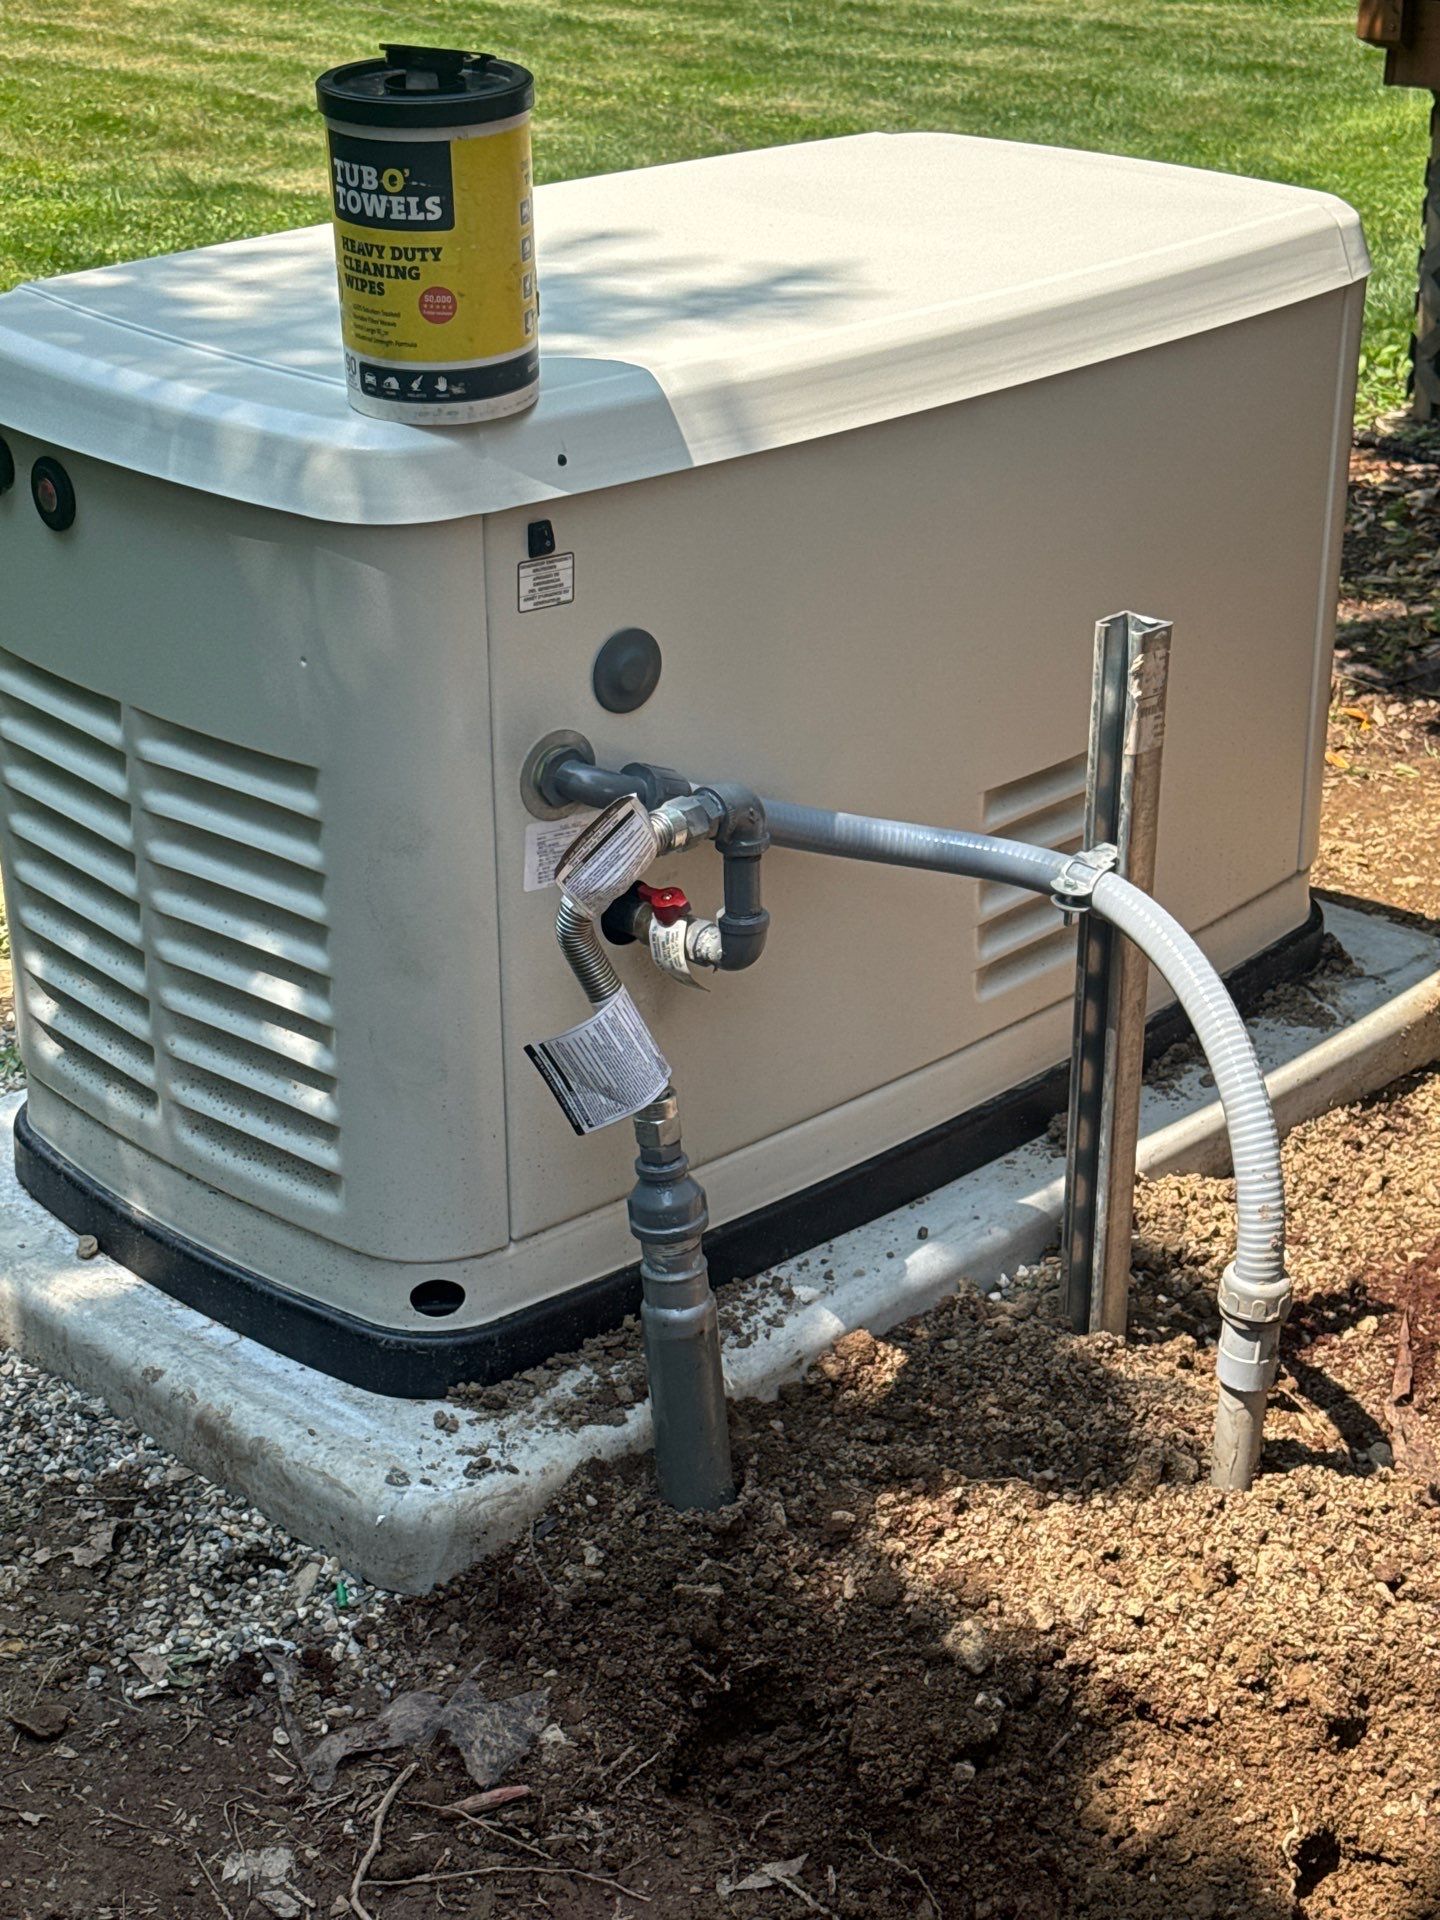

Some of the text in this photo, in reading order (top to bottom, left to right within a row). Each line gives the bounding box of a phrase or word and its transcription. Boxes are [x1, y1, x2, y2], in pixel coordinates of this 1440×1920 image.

[333, 157, 379, 191] TUB
[336, 184, 443, 221] TOWELS
[341, 235, 443, 262] HEAVY DUTY
[343, 255, 421, 281] CLEANING
[344, 272, 385, 296] WIPES
[424, 294, 452, 305] 50,000
[345, 352, 357, 376] 90
